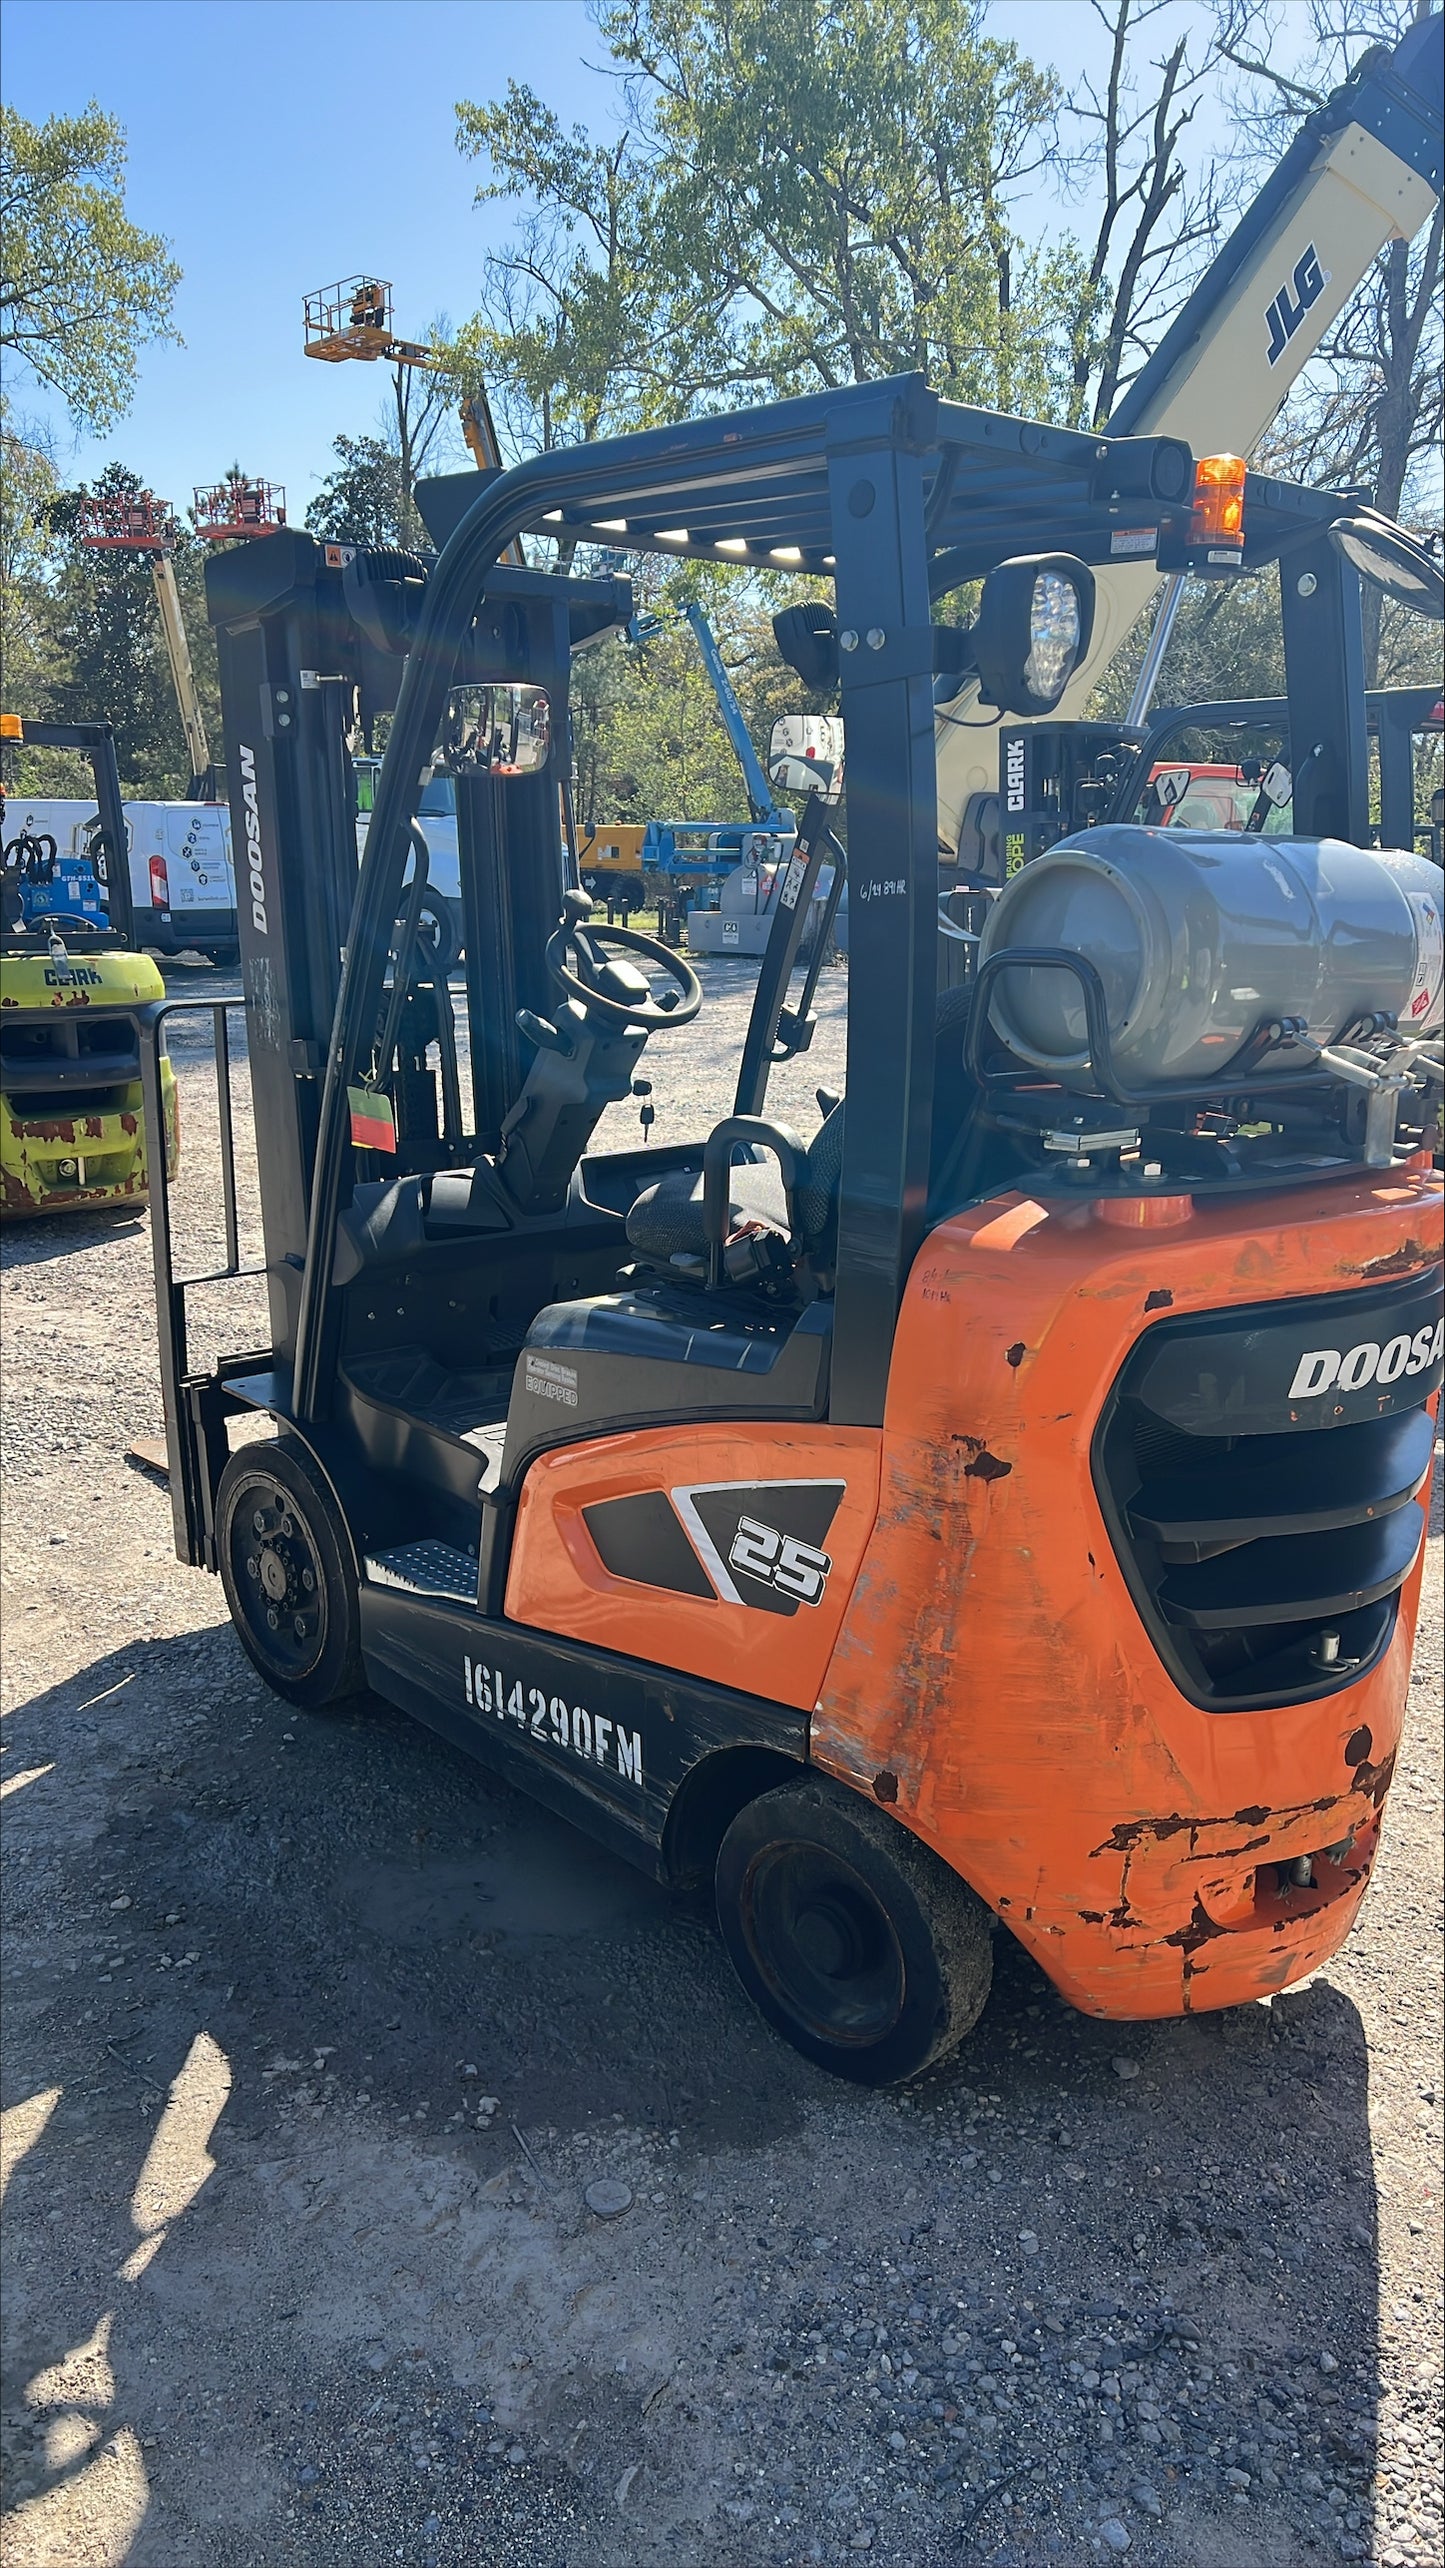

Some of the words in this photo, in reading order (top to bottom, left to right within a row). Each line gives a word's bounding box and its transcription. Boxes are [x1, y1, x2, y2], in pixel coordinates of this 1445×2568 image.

[1264, 240, 1326, 369] JLG
[1007, 739, 1025, 812] CLARK
[239, 744, 268, 935] DOOSAN
[526, 1374, 578, 1407] EQUIPPED
[728, 1515, 833, 1608] 25
[463, 1655, 643, 1786] 1614290FM
